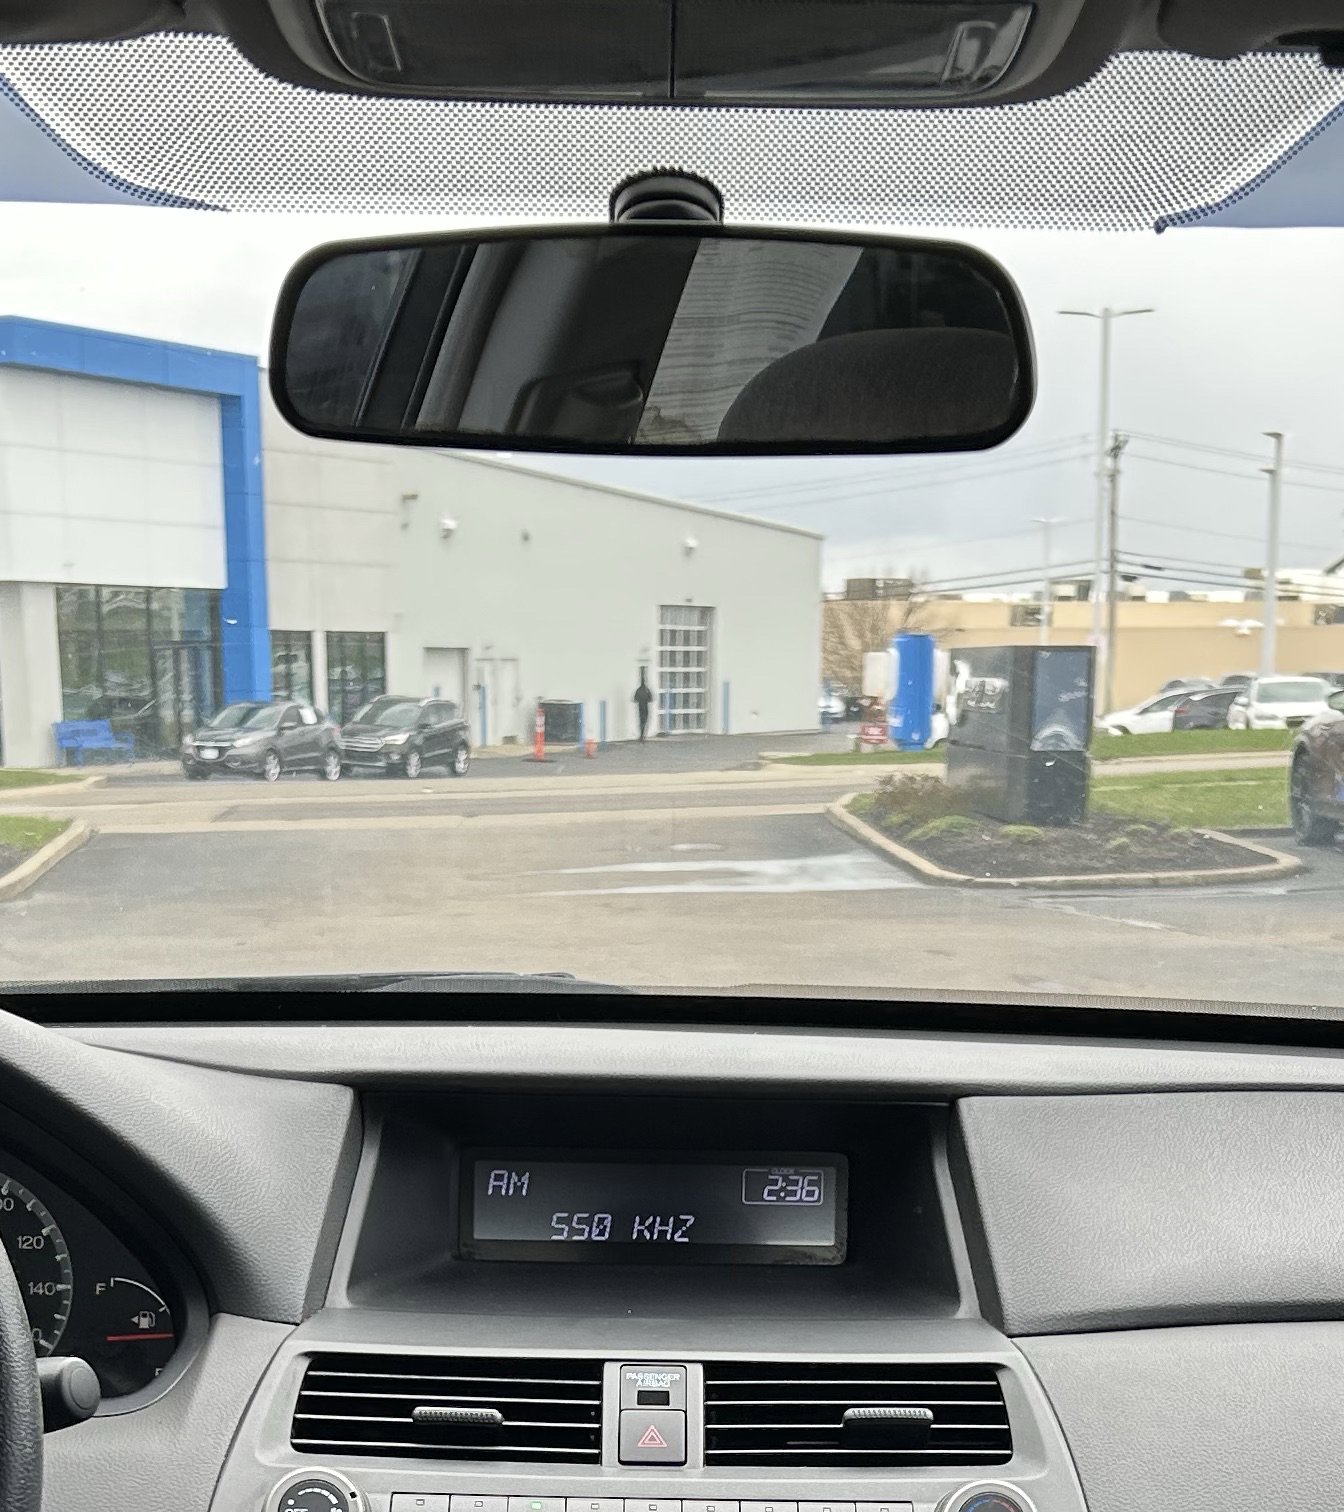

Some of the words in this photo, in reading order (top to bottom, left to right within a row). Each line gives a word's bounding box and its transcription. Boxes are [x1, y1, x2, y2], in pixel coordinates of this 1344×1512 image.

[487, 1169, 531, 1197] AM
[763, 1174, 820, 1201] 2:36
[550, 1213, 612, 1242] 550
[631, 1214, 696, 1243] KHZ
[16, 1235, 45, 1250] 120
[28, 1281, 56, 1296] 140
[95, 1283, 106, 1295] F
